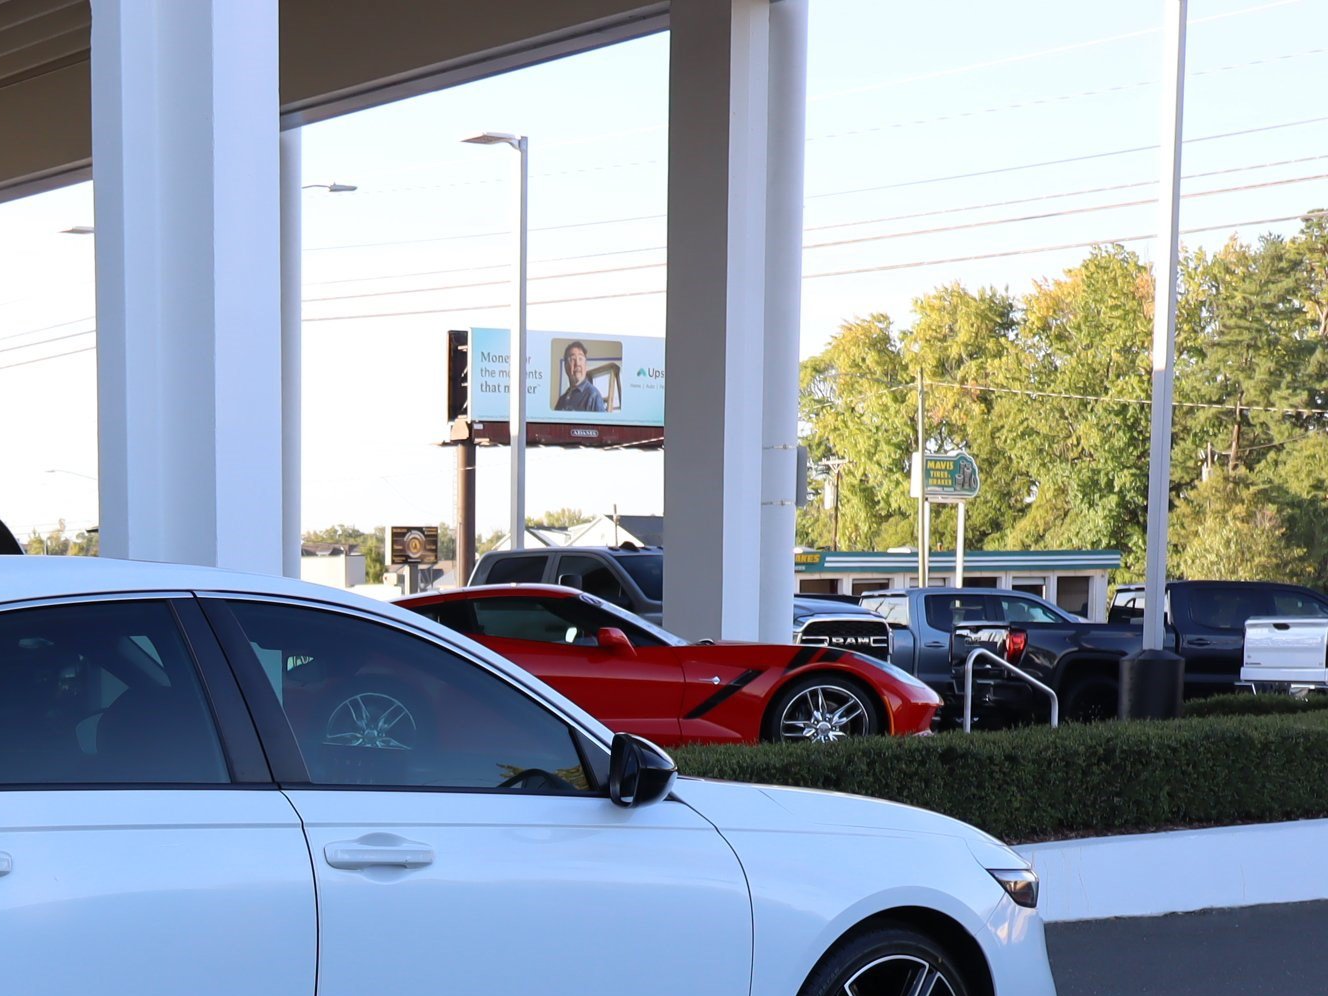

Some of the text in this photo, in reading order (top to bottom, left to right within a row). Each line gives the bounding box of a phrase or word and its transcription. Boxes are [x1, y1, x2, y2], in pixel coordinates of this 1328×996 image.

[480, 351, 510, 364] Mone
[480, 367, 543, 380] the mnts
[648, 368, 664, 379] Ups
[480, 381, 502, 393] that
[927, 460, 954, 470] MAVIS
[796, 553, 821, 563] AKES
[832, 637, 869, 645] RAM
